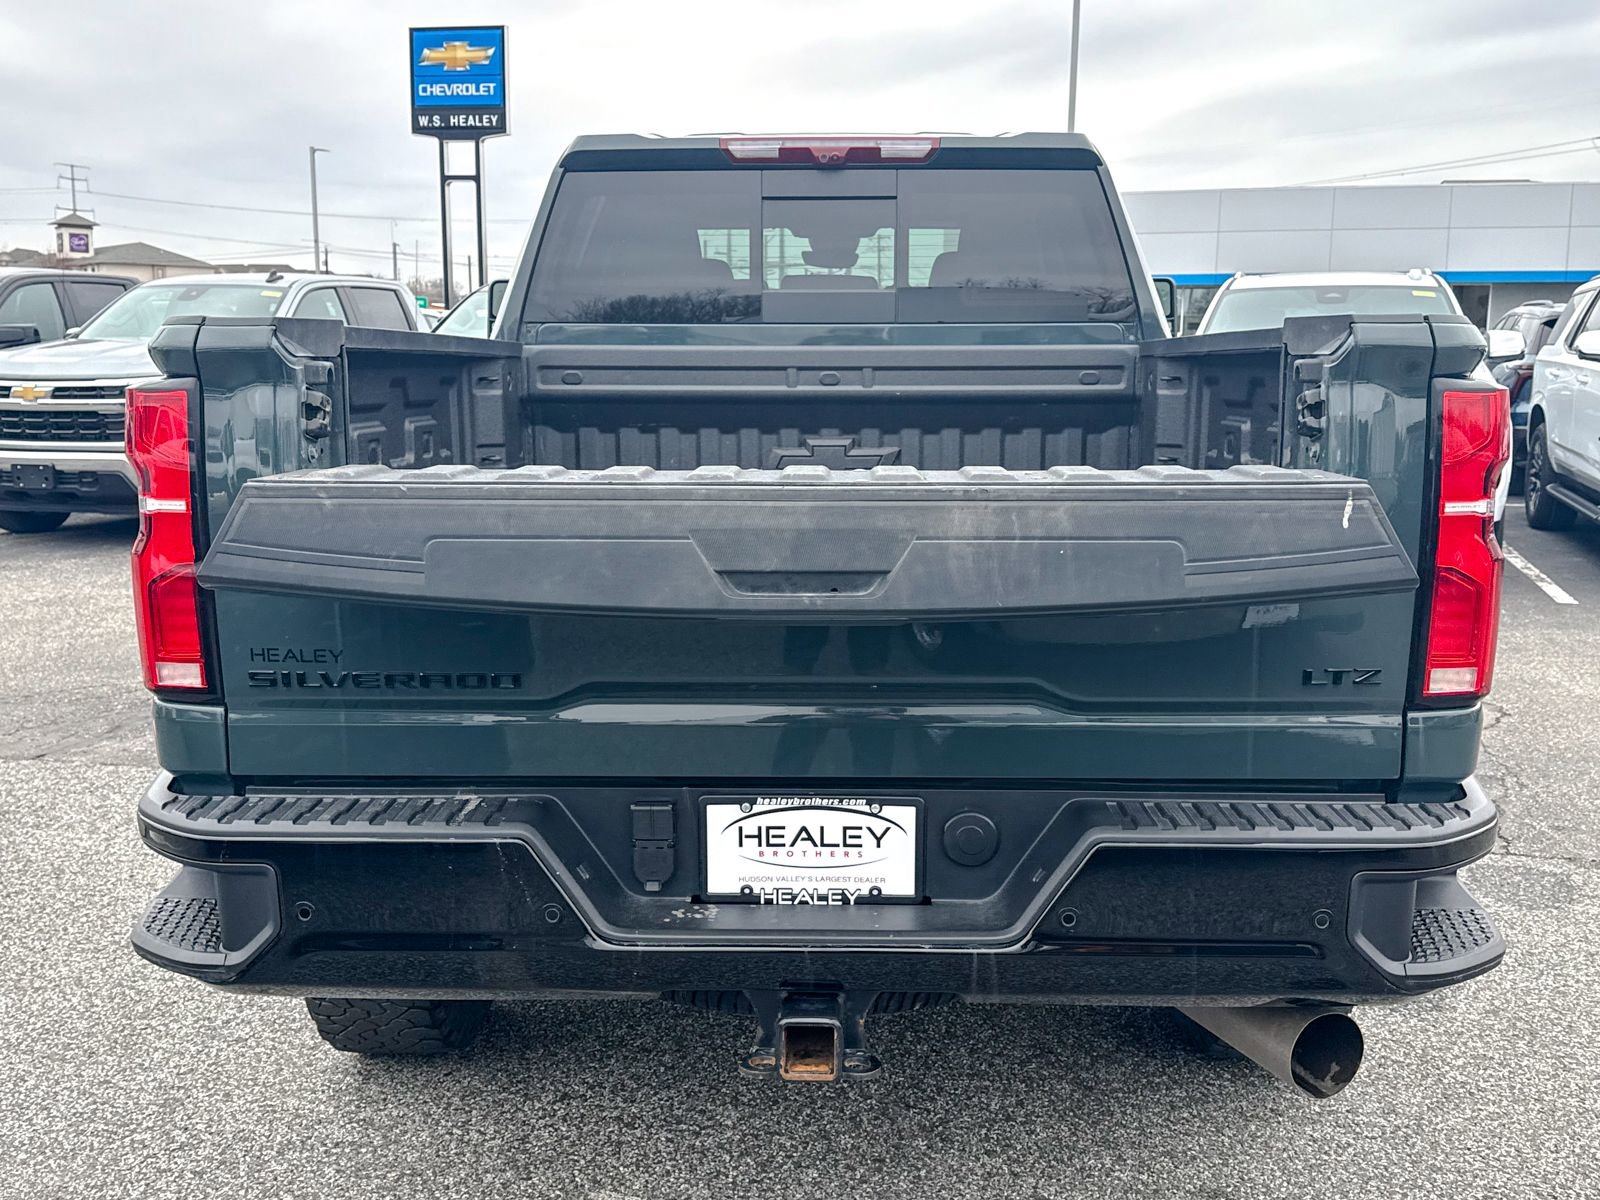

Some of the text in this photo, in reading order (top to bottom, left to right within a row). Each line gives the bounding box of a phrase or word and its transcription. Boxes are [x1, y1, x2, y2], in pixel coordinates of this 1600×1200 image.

[418, 83, 496, 96] CHEVROLET
[418, 114, 499, 127] W.S. HEALEY
[250, 647, 344, 664] HEALEY
[248, 670, 522, 689] SILVERADO
[1302, 668, 1382, 685] LTZ
[756, 797, 867, 806] healeybrothers.com
[738, 825, 892, 849] HEALEY
[759, 850, 863, 858] BROTHERS
[738, 875, 774, 883] HUDSON
[776, 875, 813, 883] VALLEY'S
[853, 876, 886, 884] DEALER
[760, 888, 862, 905] HEALEY
